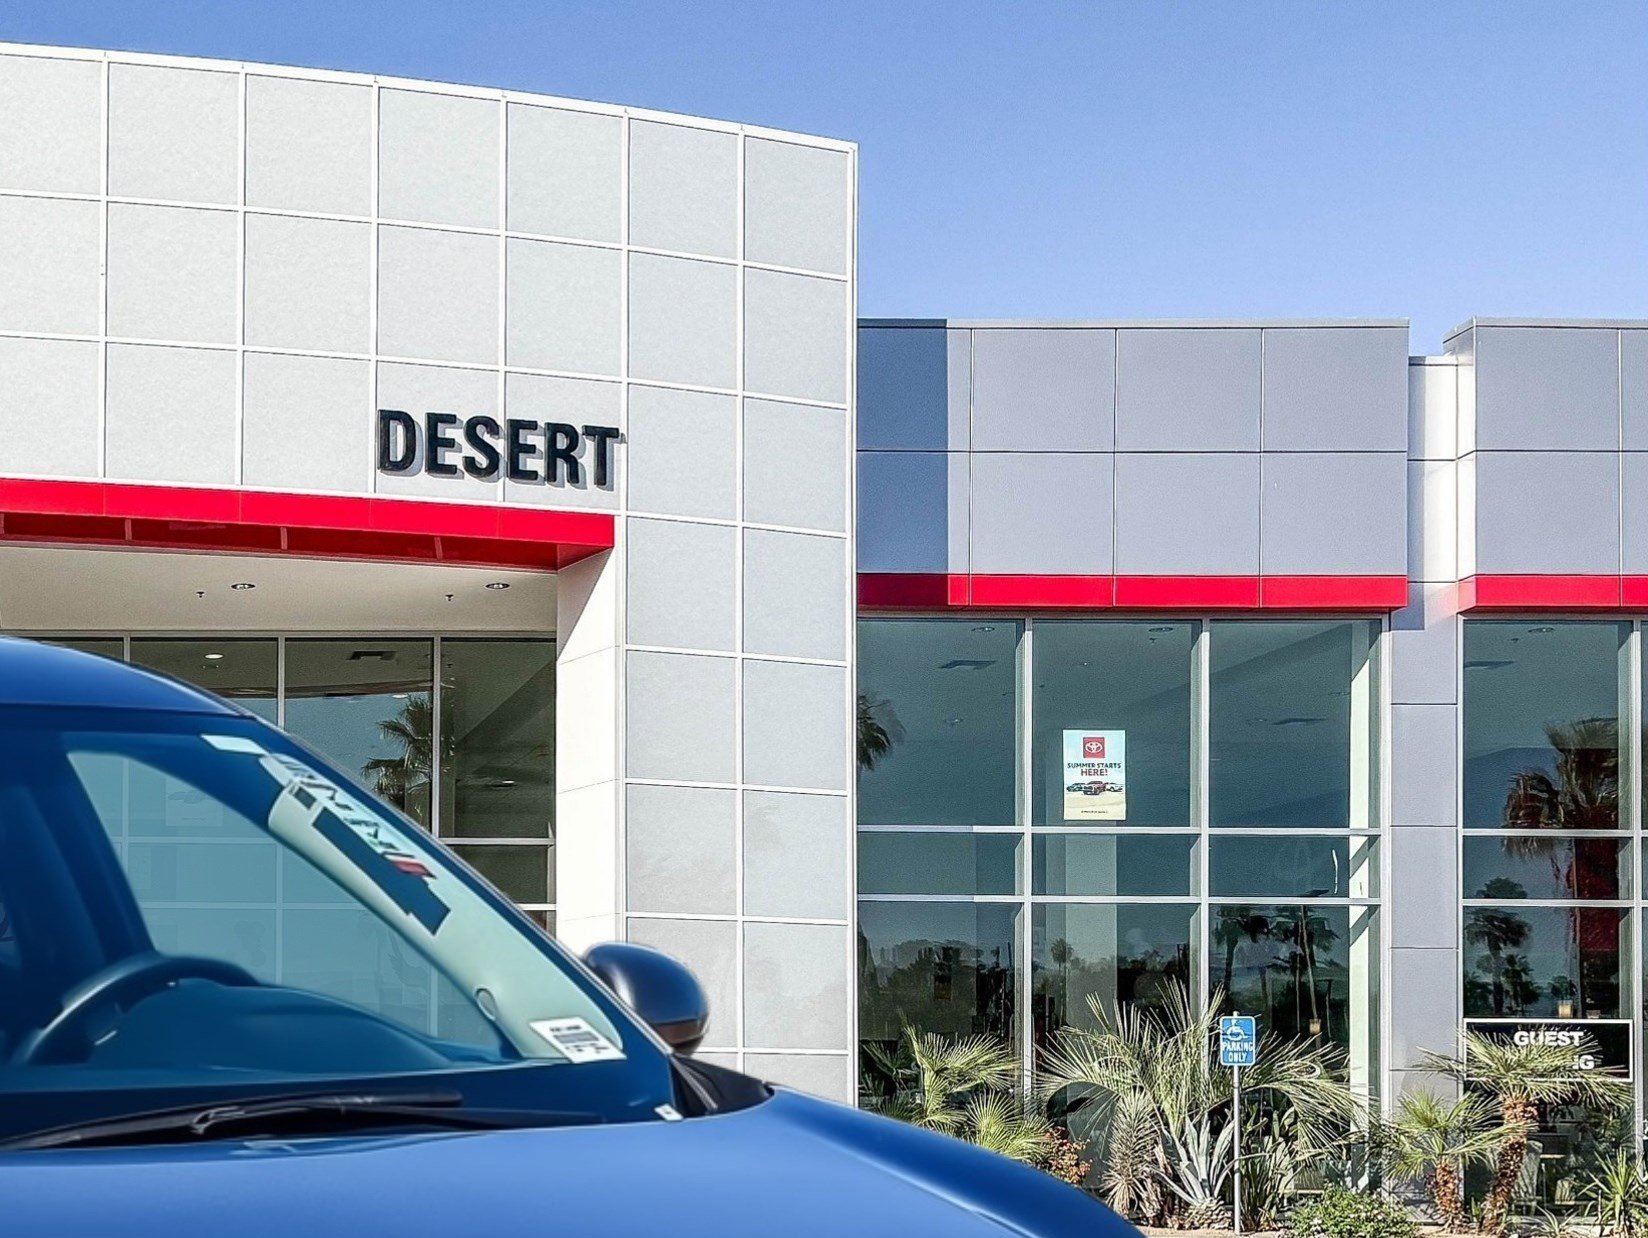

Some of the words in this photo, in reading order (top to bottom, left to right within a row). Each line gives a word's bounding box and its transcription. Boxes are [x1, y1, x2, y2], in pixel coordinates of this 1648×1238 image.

[377, 409, 620, 487] DESERT
[1081, 768, 1108, 776] HERE!
[1513, 1031, 1584, 1047] GUEST
[1222, 1041, 1254, 1052] PARKING
[1228, 1051, 1248, 1063] ONLY
